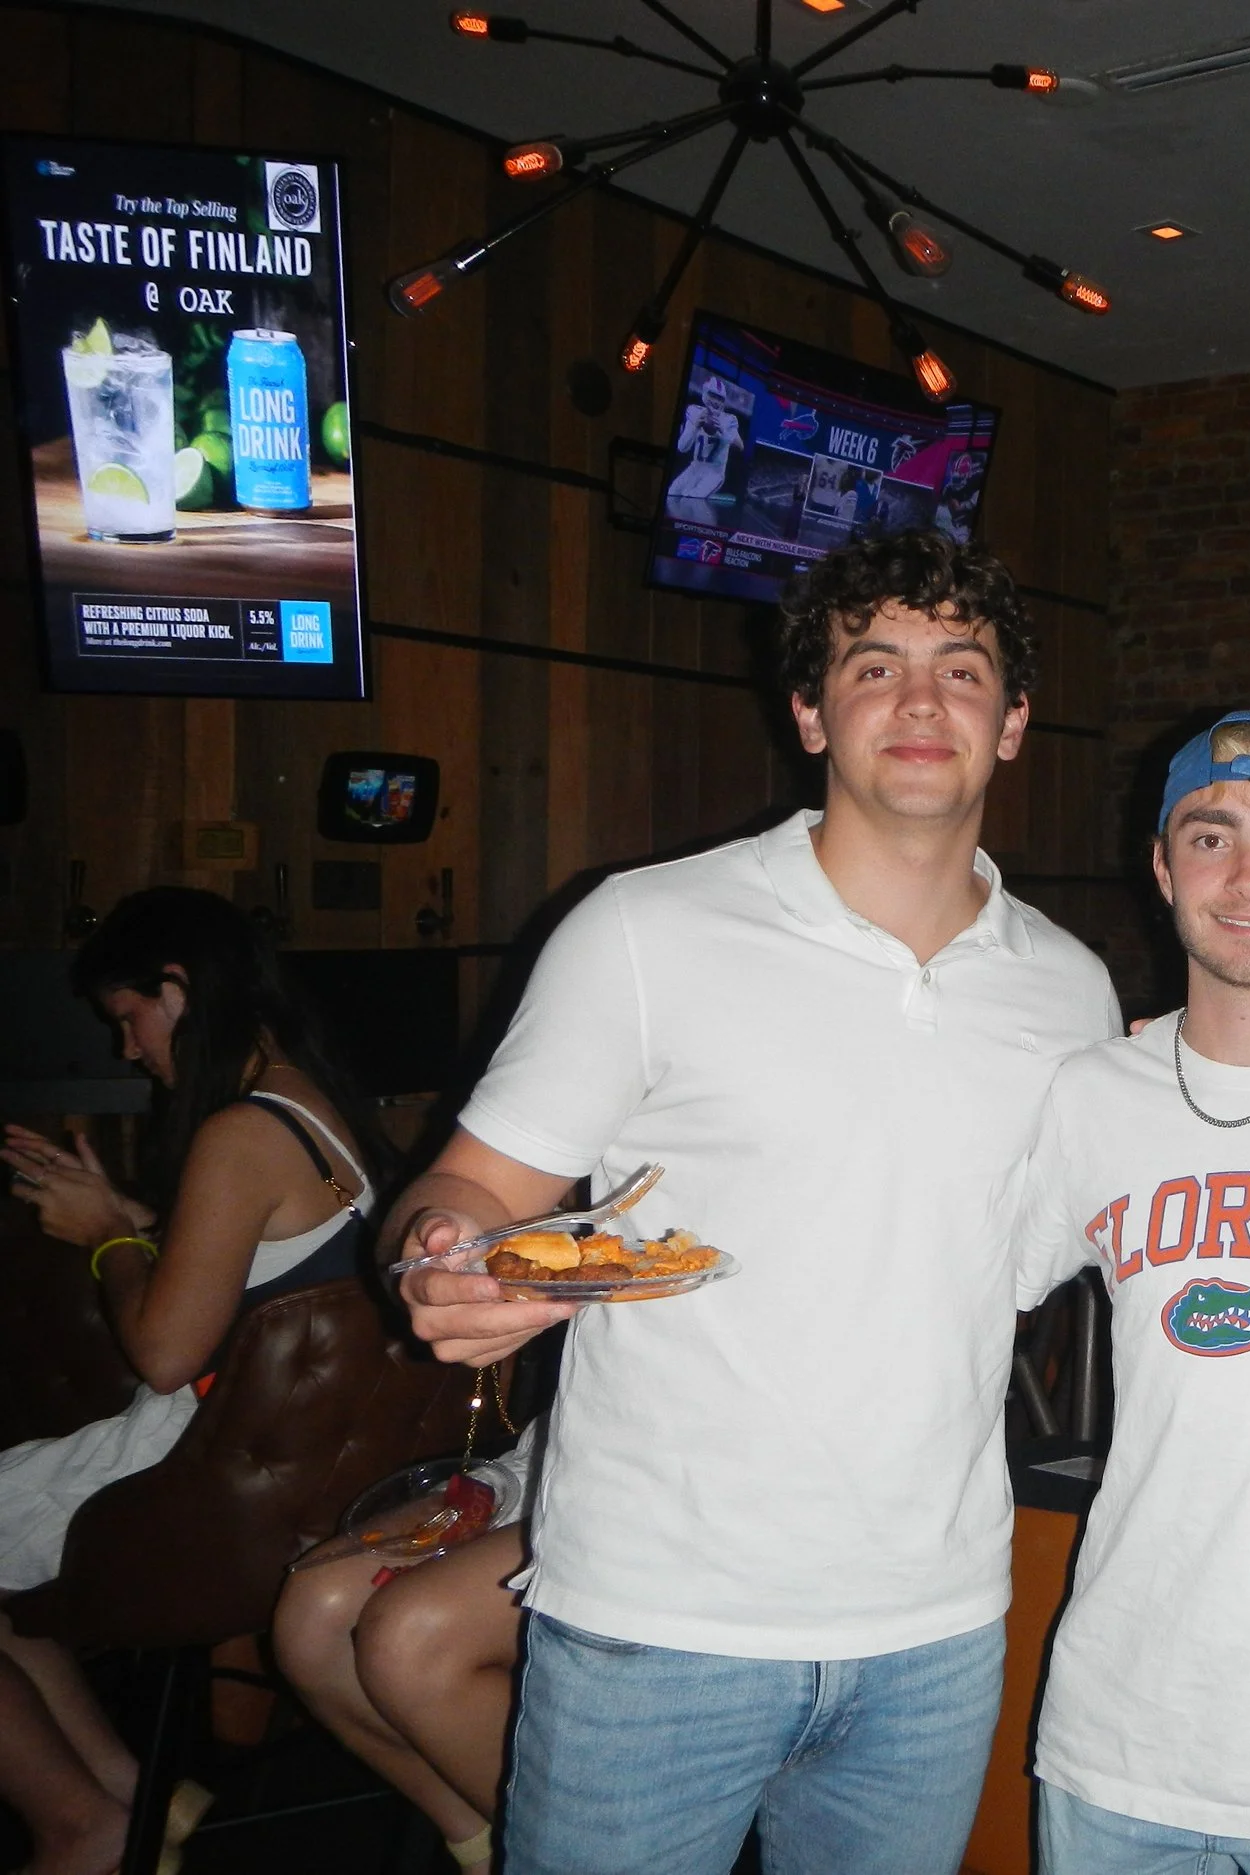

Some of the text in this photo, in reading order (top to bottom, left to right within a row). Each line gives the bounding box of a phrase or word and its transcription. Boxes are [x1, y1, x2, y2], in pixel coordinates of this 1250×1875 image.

[115, 194, 238, 223] Try the Top Selling
[284, 189, 305, 205] oak
[38, 219, 313, 277] TASTE OF FINLAND
[145, 281, 234, 315] @ OAK
[239, 386, 296, 424] LONG
[238, 424, 303, 460] DRINK
[828, 426, 879, 464] WEEK 6
[81, 604, 210, 623] REFRESHING CITRUS SODA
[249, 610, 275, 625] 5.5%
[291, 614, 320, 631] LONG
[83, 621, 234, 640] WITH A PREMIUM LIQUOR KICK.
[290, 631, 324, 649] DRINK
